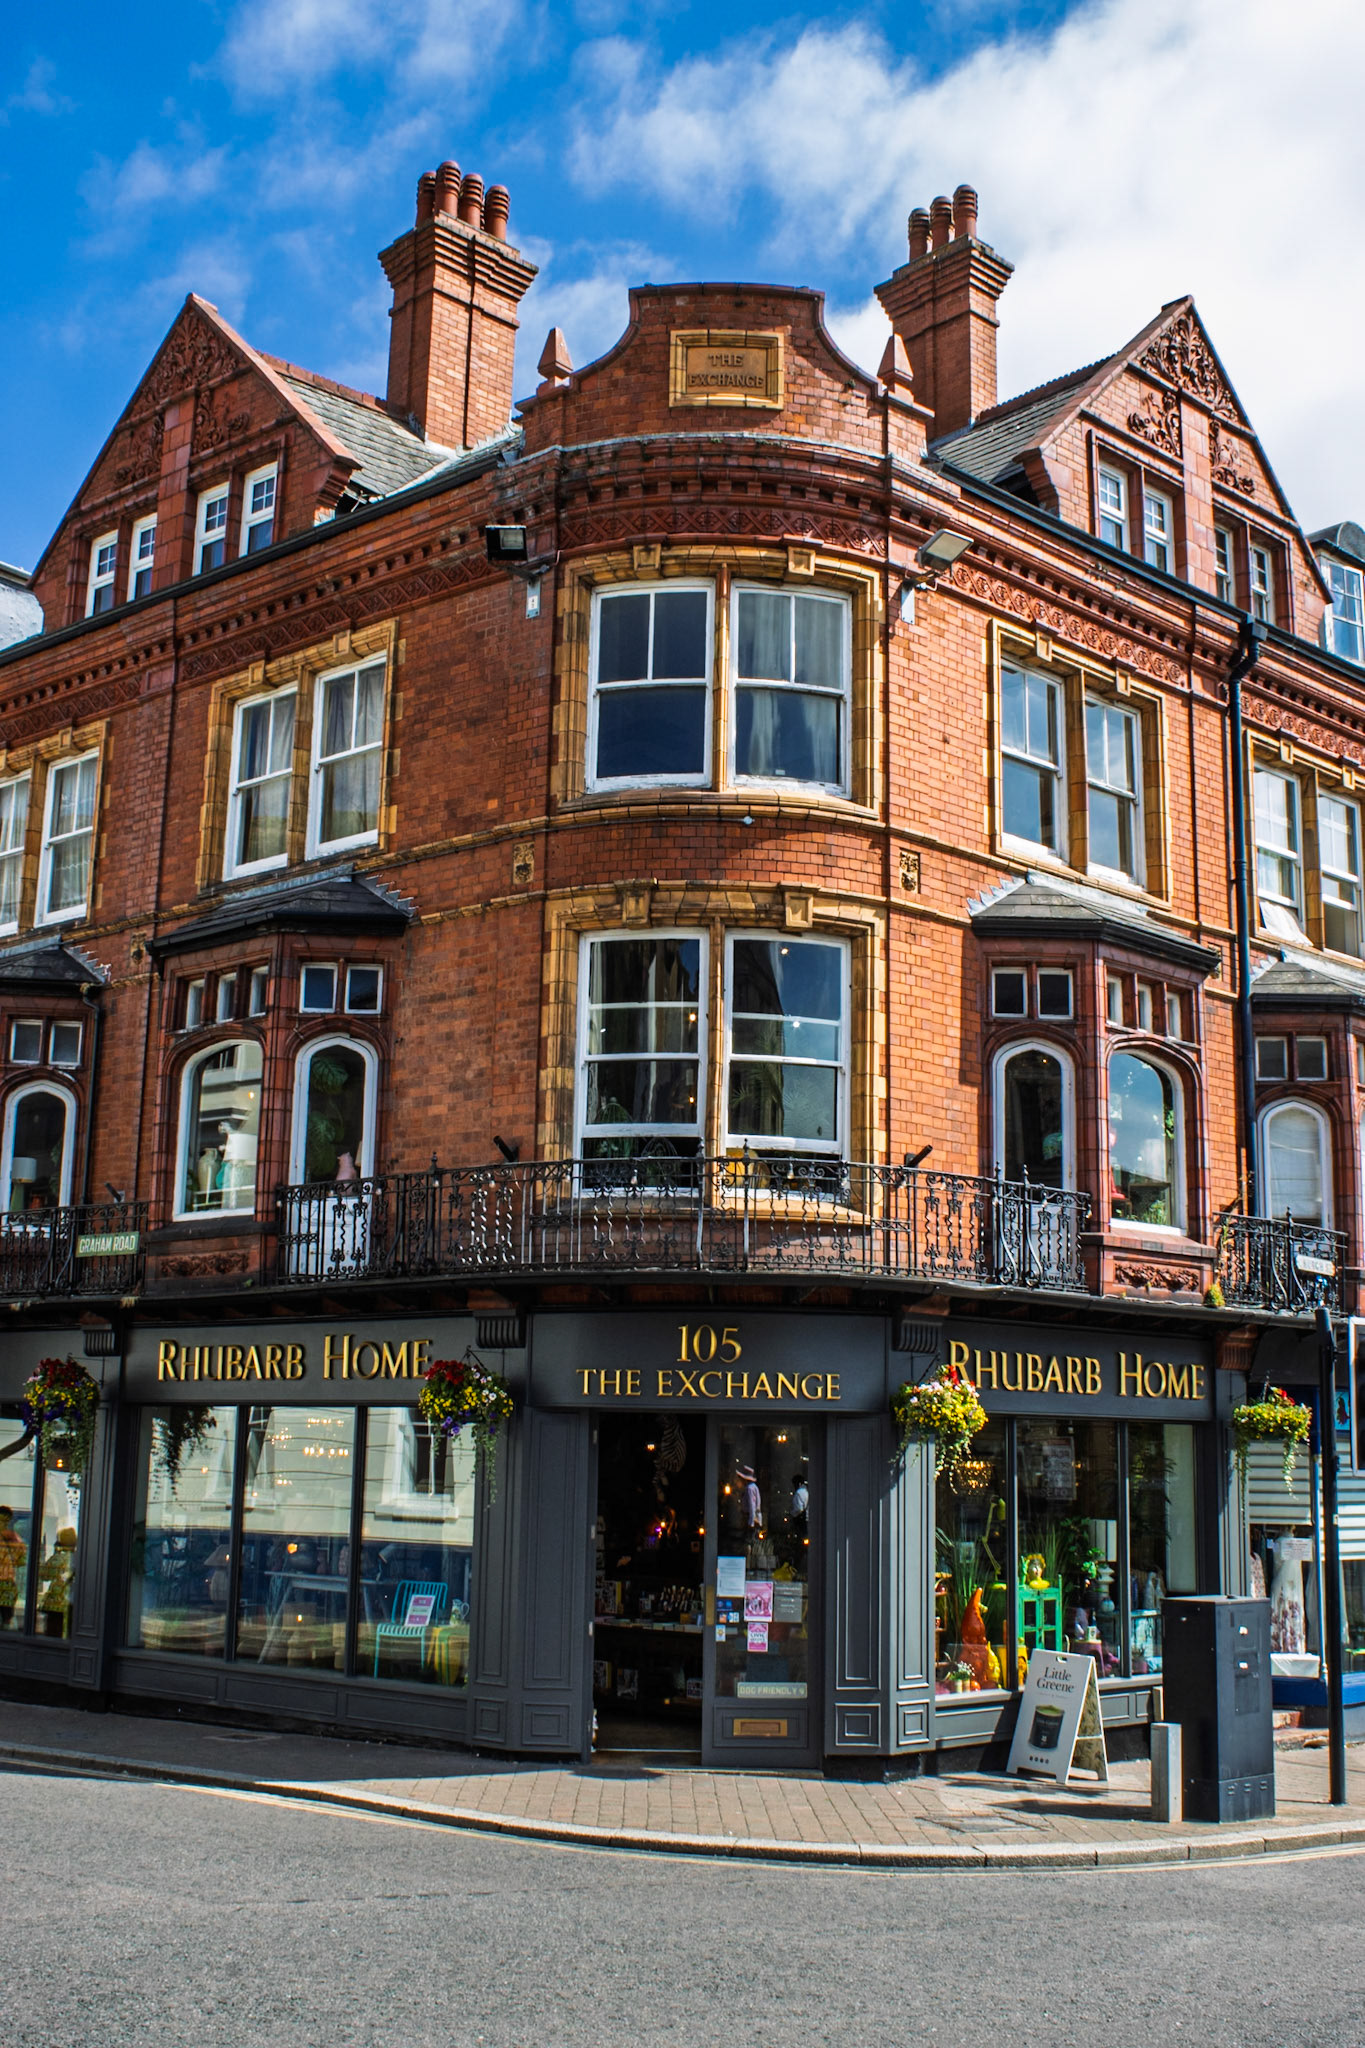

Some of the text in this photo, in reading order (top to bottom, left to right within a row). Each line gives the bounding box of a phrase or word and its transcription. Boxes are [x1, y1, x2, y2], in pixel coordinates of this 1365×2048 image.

[708, 353, 744, 367] THE
[687, 373, 764, 388] EXCHANGE
[79, 1235, 136, 1253] GRAHAM ROAD
[676, 1324, 742, 1363] 105
[157, 1333, 433, 1381] RHUBARB HOME
[949, 1339, 1206, 1400] RHUBARB HOME
[576, 1368, 841, 1400] THE EXCHANGE
[1044, 1666, 1072, 1681] Little
[739, 1686, 797, 1695] DOG FRIENDLY
[1036, 1677, 1074, 1693] Greene
